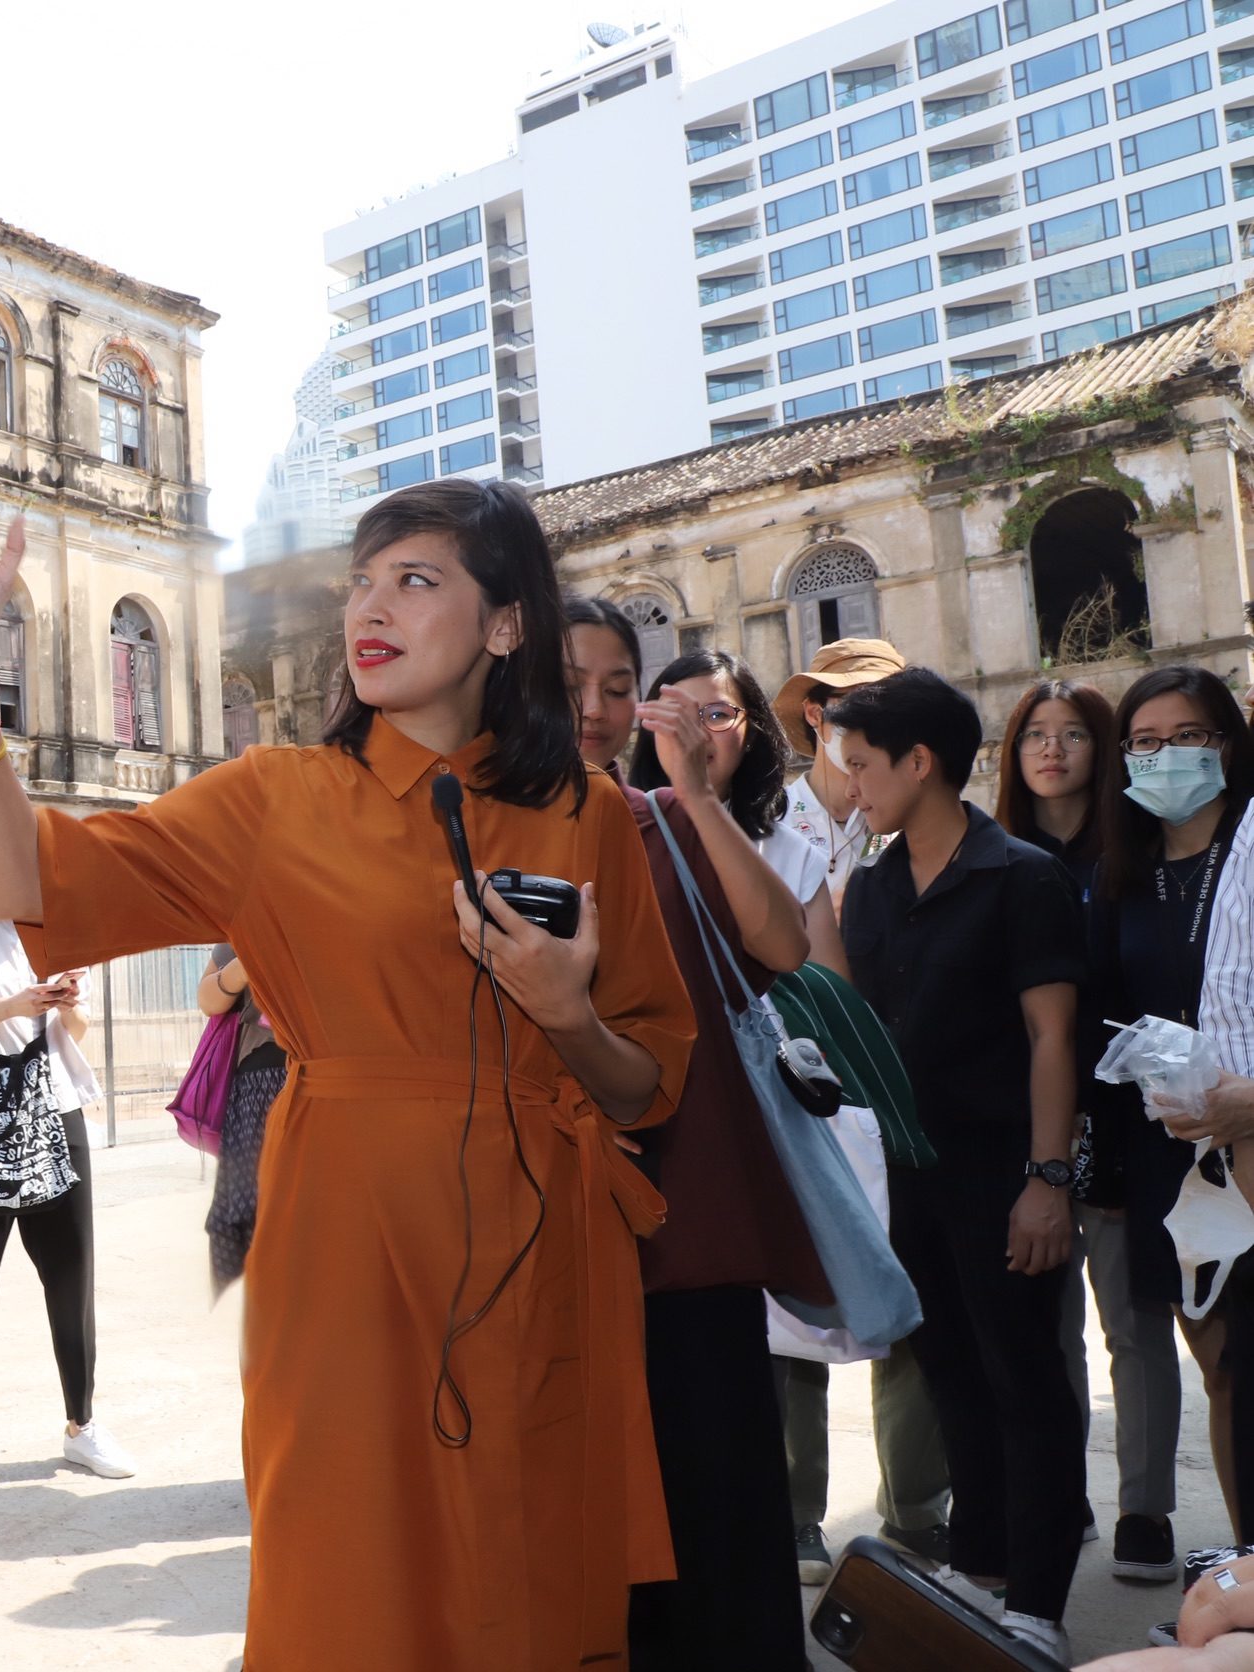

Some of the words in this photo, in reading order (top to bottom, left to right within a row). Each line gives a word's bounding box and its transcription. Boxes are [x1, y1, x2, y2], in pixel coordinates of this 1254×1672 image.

[1155, 867, 1167, 901] STAFF
[1188, 901, 1205, 943] BANGKOK
[1199, 868, 1214, 899] DESIGN
[1207, 842, 1221, 866] WEEK
